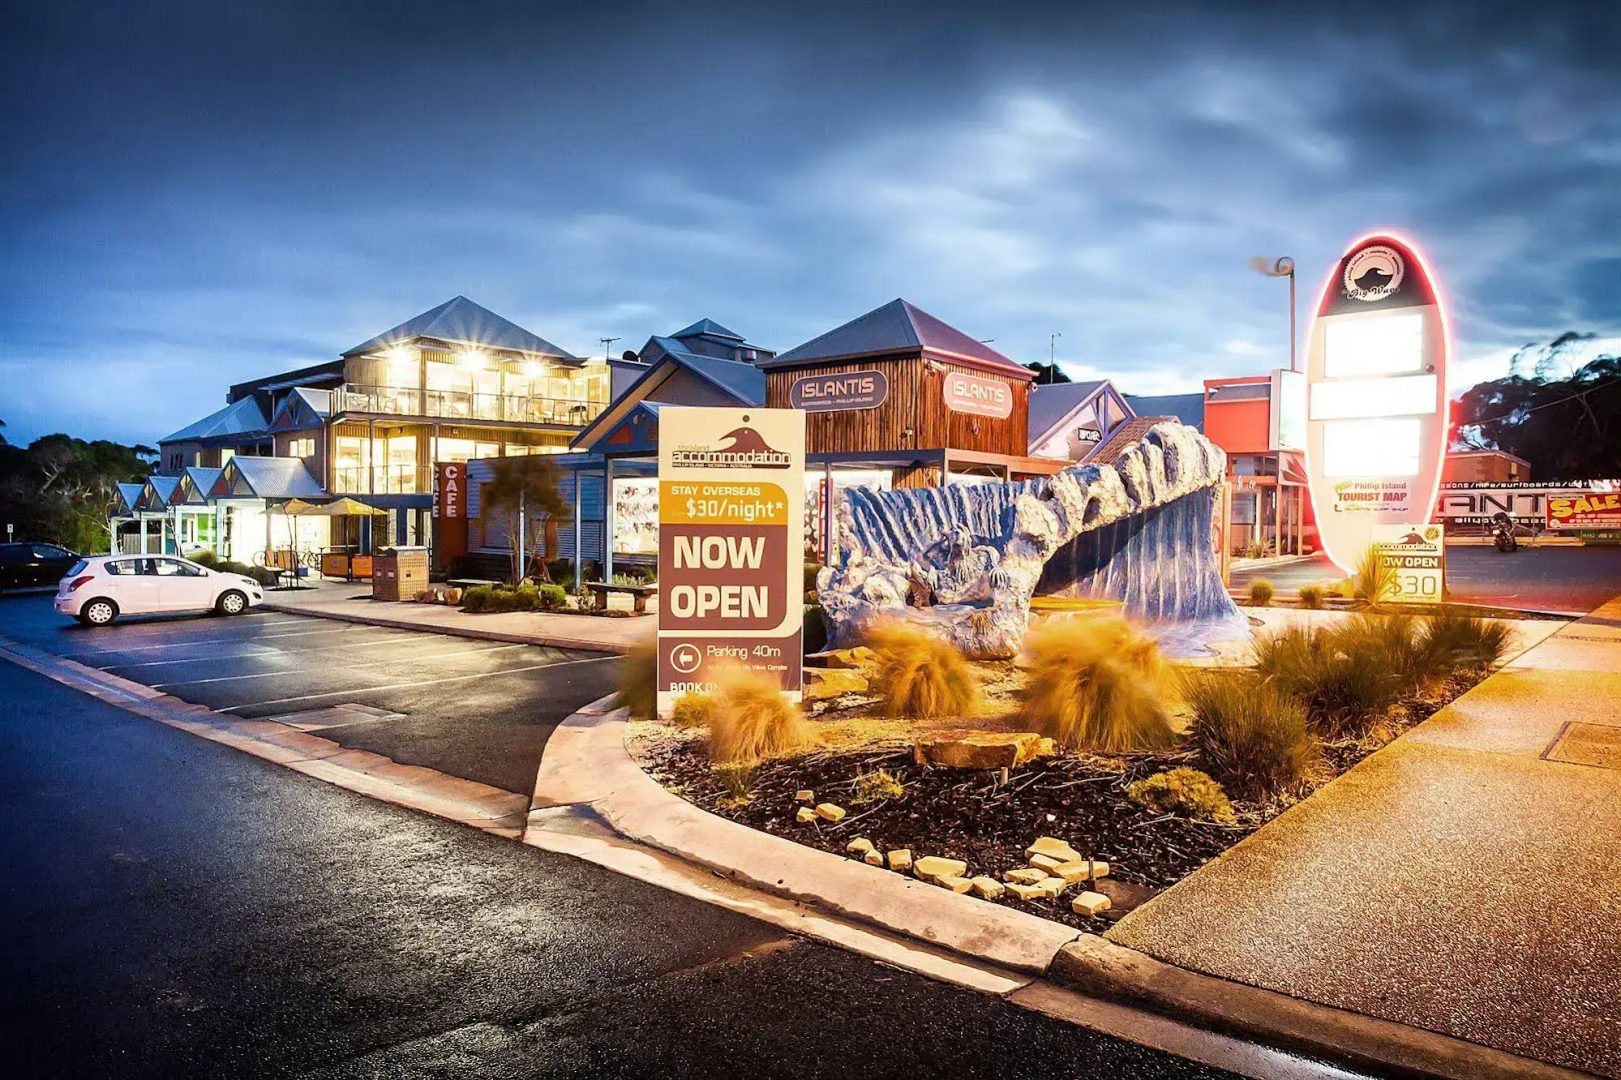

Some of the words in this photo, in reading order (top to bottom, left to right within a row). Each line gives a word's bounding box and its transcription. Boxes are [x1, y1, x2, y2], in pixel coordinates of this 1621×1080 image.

[802, 377, 875, 398] ISLANTIS
[953, 380, 1005, 403] ISLANTIS
[672, 448, 791, 464] accommodation
[445, 465, 458, 518] CAFE
[671, 486, 699, 496] STAY
[702, 486, 761, 497] OVERSEAS
[1354, 482, 1380, 490] Phillip
[1381, 482, 1407, 490] Island
[1337, 492, 1381, 502] TOURIST
[1382, 492, 1408, 502] MAP
[1438, 493, 1546, 513] ANT
[1550, 494, 1620, 518] SALE
[673, 535, 766, 569] NOW
[1383, 557, 1404, 567] OW
[1405, 557, 1438, 567] OPEN
[1389, 573, 1437, 596] $30
[670, 585, 769, 618] OPEN
[706, 645, 748, 660] Parking
[752, 645, 781, 657] 40m
[669, 682, 702, 692] BOOK
